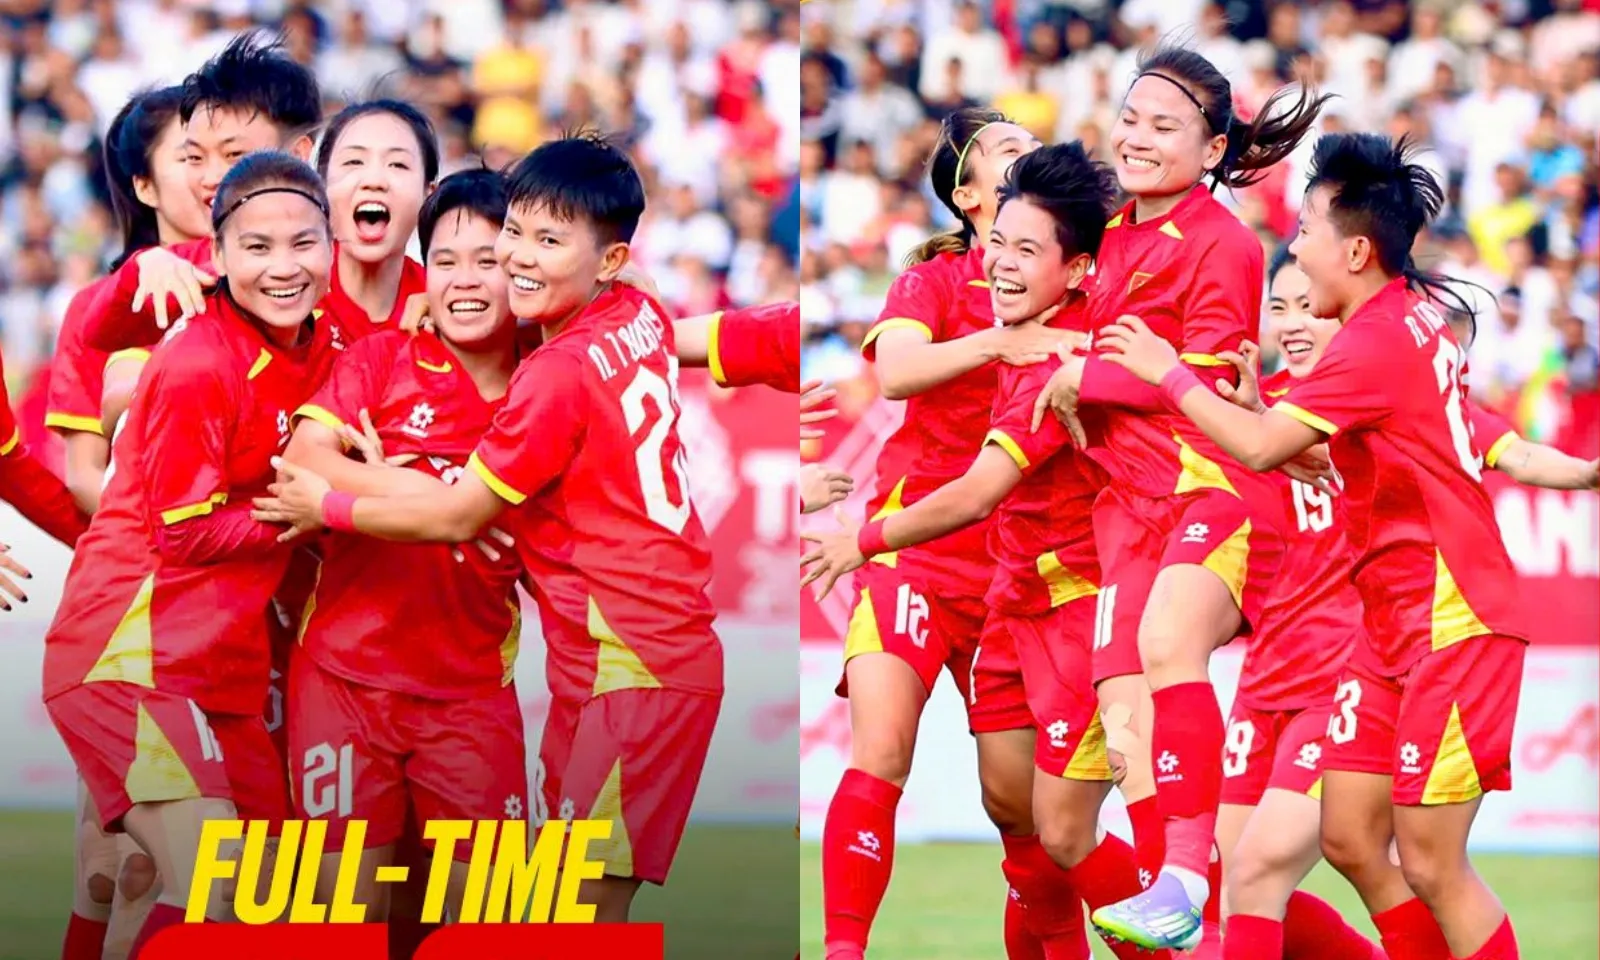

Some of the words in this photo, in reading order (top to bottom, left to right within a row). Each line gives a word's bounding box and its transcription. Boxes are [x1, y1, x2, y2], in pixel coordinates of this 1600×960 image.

[620, 345, 691, 536] 2
[1432, 334, 1484, 483] 2
[302, 741, 354, 819] 21
[1221, 716, 1256, 779] 9
